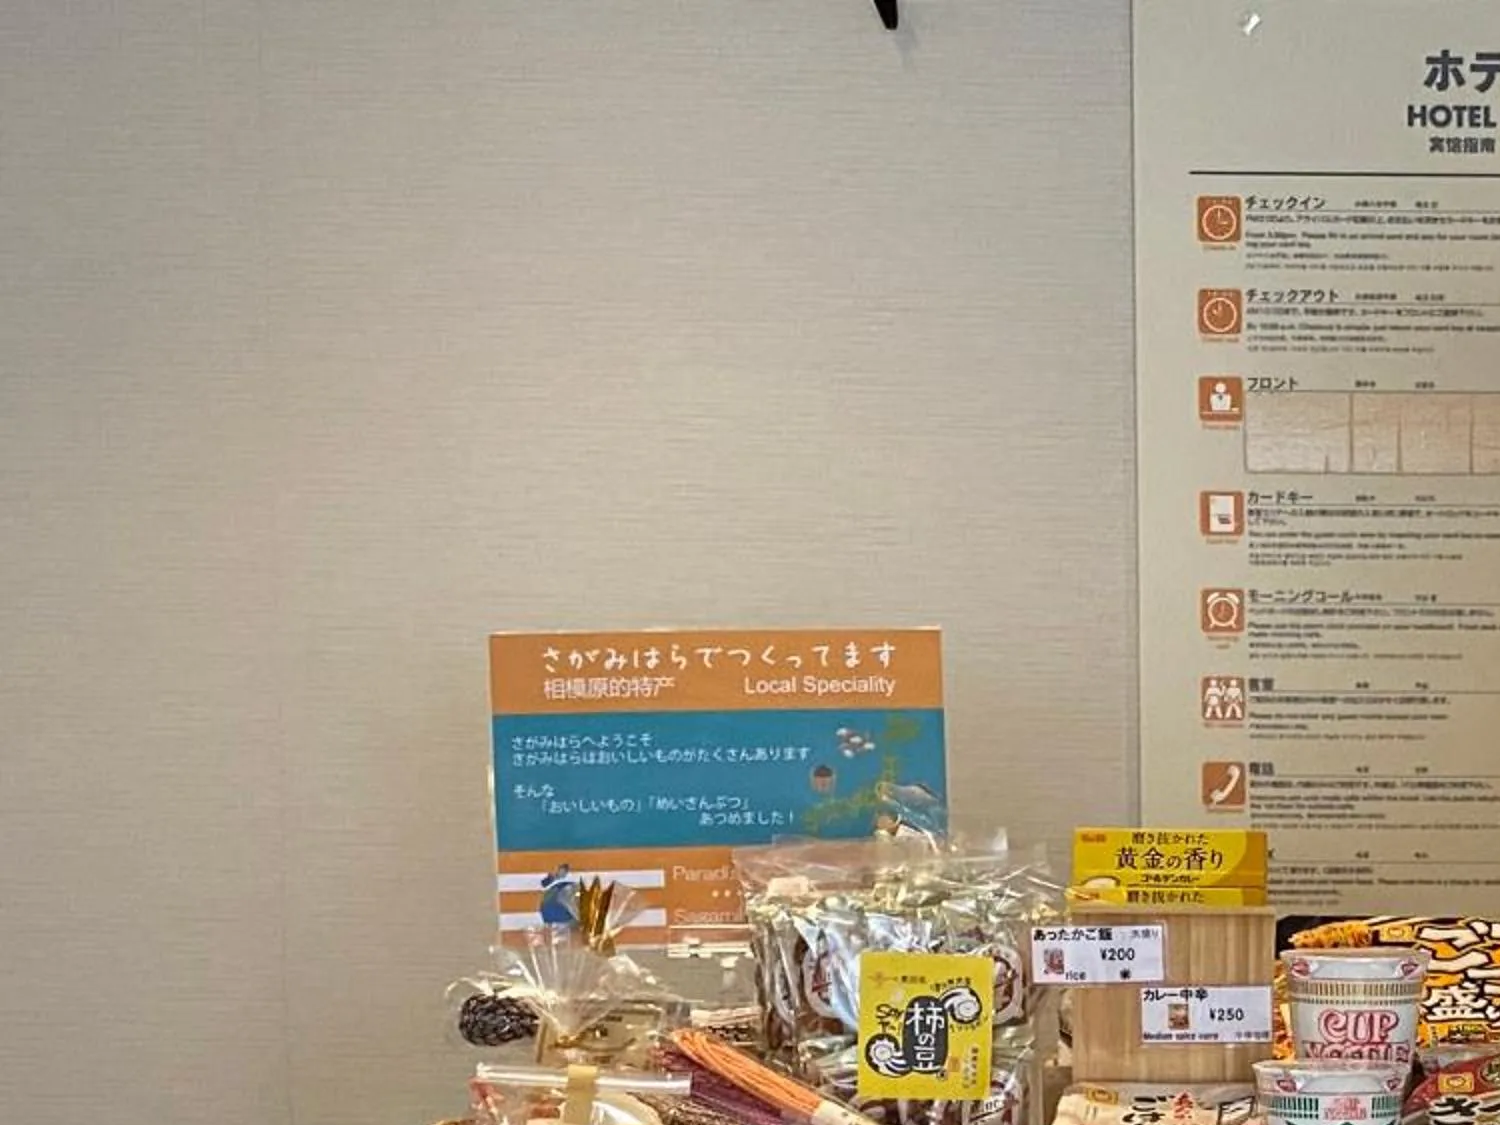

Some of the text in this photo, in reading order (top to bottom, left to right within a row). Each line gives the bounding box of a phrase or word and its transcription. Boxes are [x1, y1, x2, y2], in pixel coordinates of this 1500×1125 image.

[1407, 105, 1497, 129] HOTEL
[1245, 195, 1326, 210] チェックイン
[1246, 288, 1339, 303] チェックアウト
[1247, 377, 1299, 391] フロント
[1248, 490, 1313, 504] カードキー
[1248, 588, 1352, 602] モーニングコール
[541, 641, 897, 673] さがみはらでつくってます
[544, 677, 675, 699] 相模原的特产
[744, 676, 895, 696] Local Speciality
[511, 733, 653, 750] さがみはらへようこそ
[511, 746, 812, 768] さがみはらはおいしいものがたくさんあります
[512, 784, 555, 798] そんな
[1115, 847, 1224, 871] 黄金の香り
[1033, 928, 1113, 942] あったかご飯
[1100, 947, 1135, 961] ¥200
[1065, 970, 1086, 981] rice
[1143, 988, 1209, 1002] カレー中辛
[1209, 1007, 1245, 1021] ¥250
[1318, 1007, 1400, 1045] CUP
